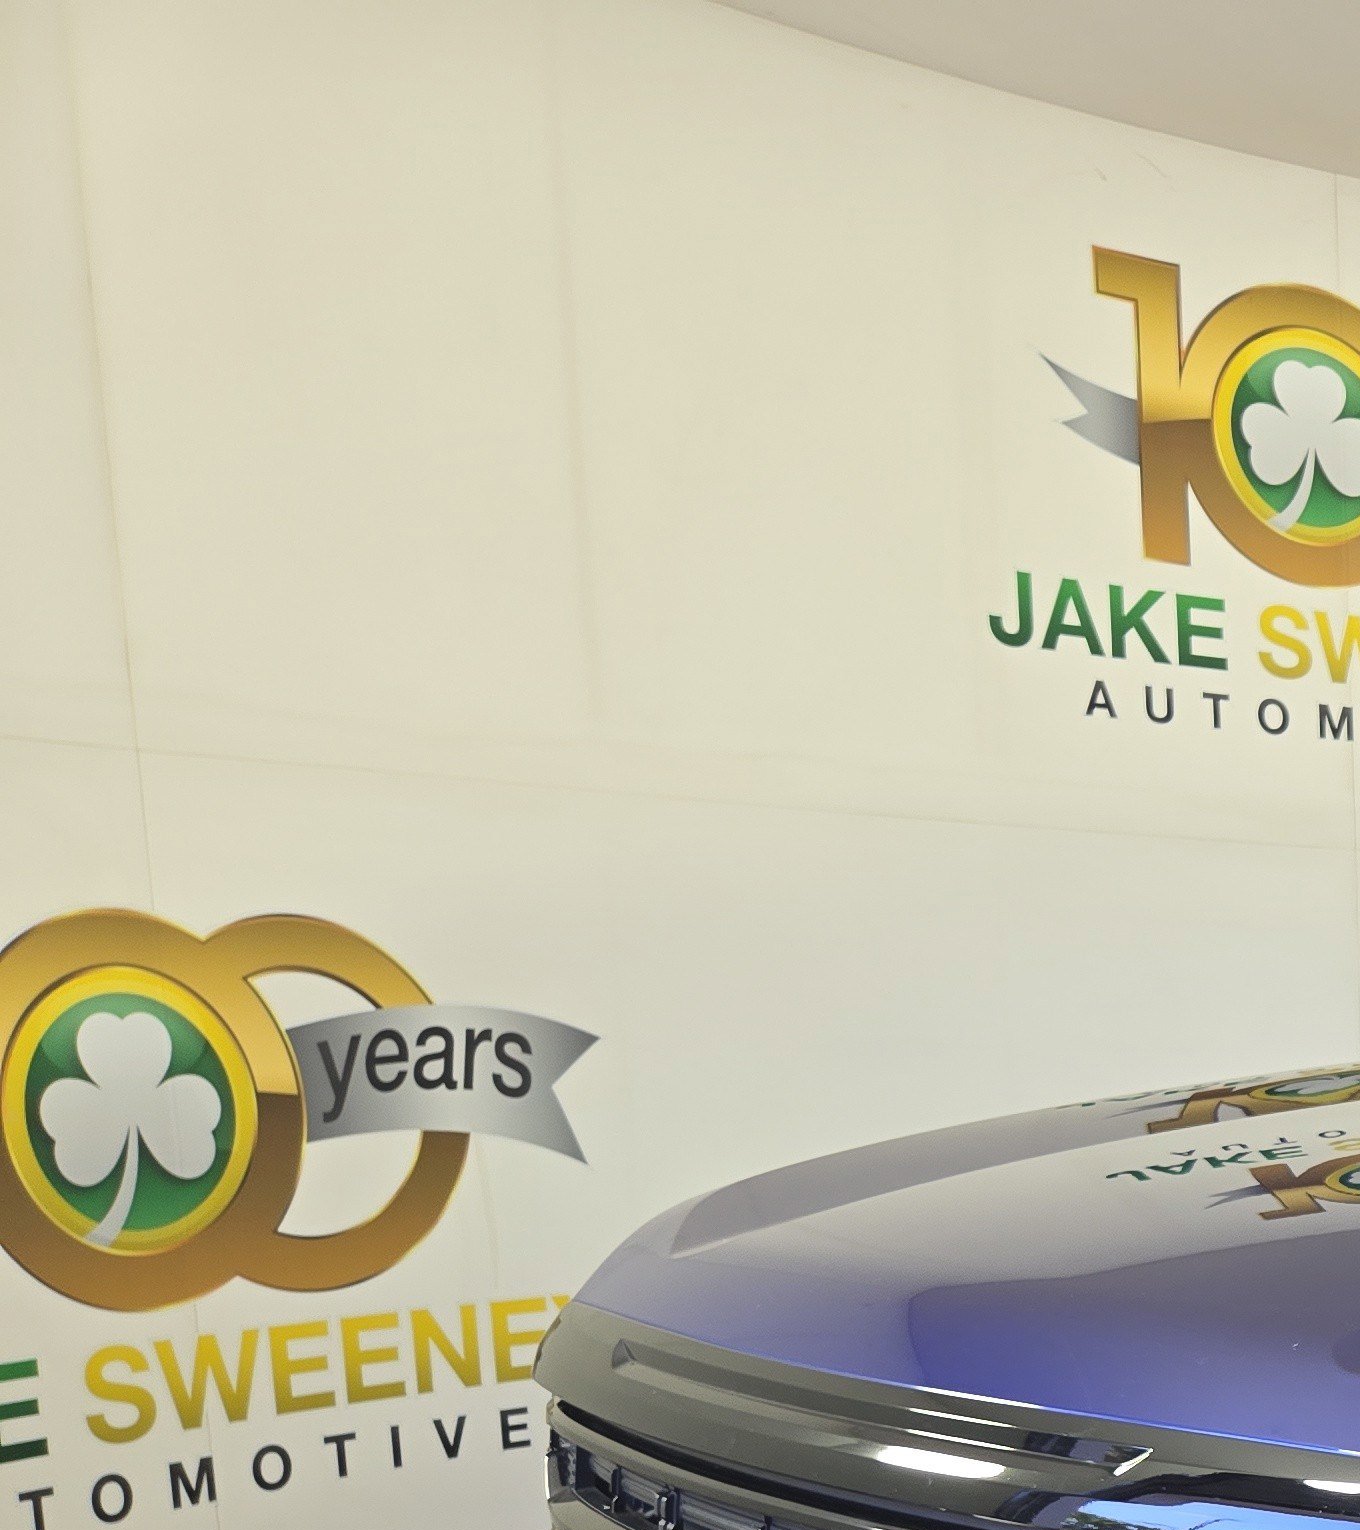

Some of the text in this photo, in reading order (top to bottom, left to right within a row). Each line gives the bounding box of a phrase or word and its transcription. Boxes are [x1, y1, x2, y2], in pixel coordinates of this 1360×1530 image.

[988, 569, 1229, 672] JAKE
[316, 1023, 533, 1123] years
[83, 1293, 571, 1444] SWEENE
